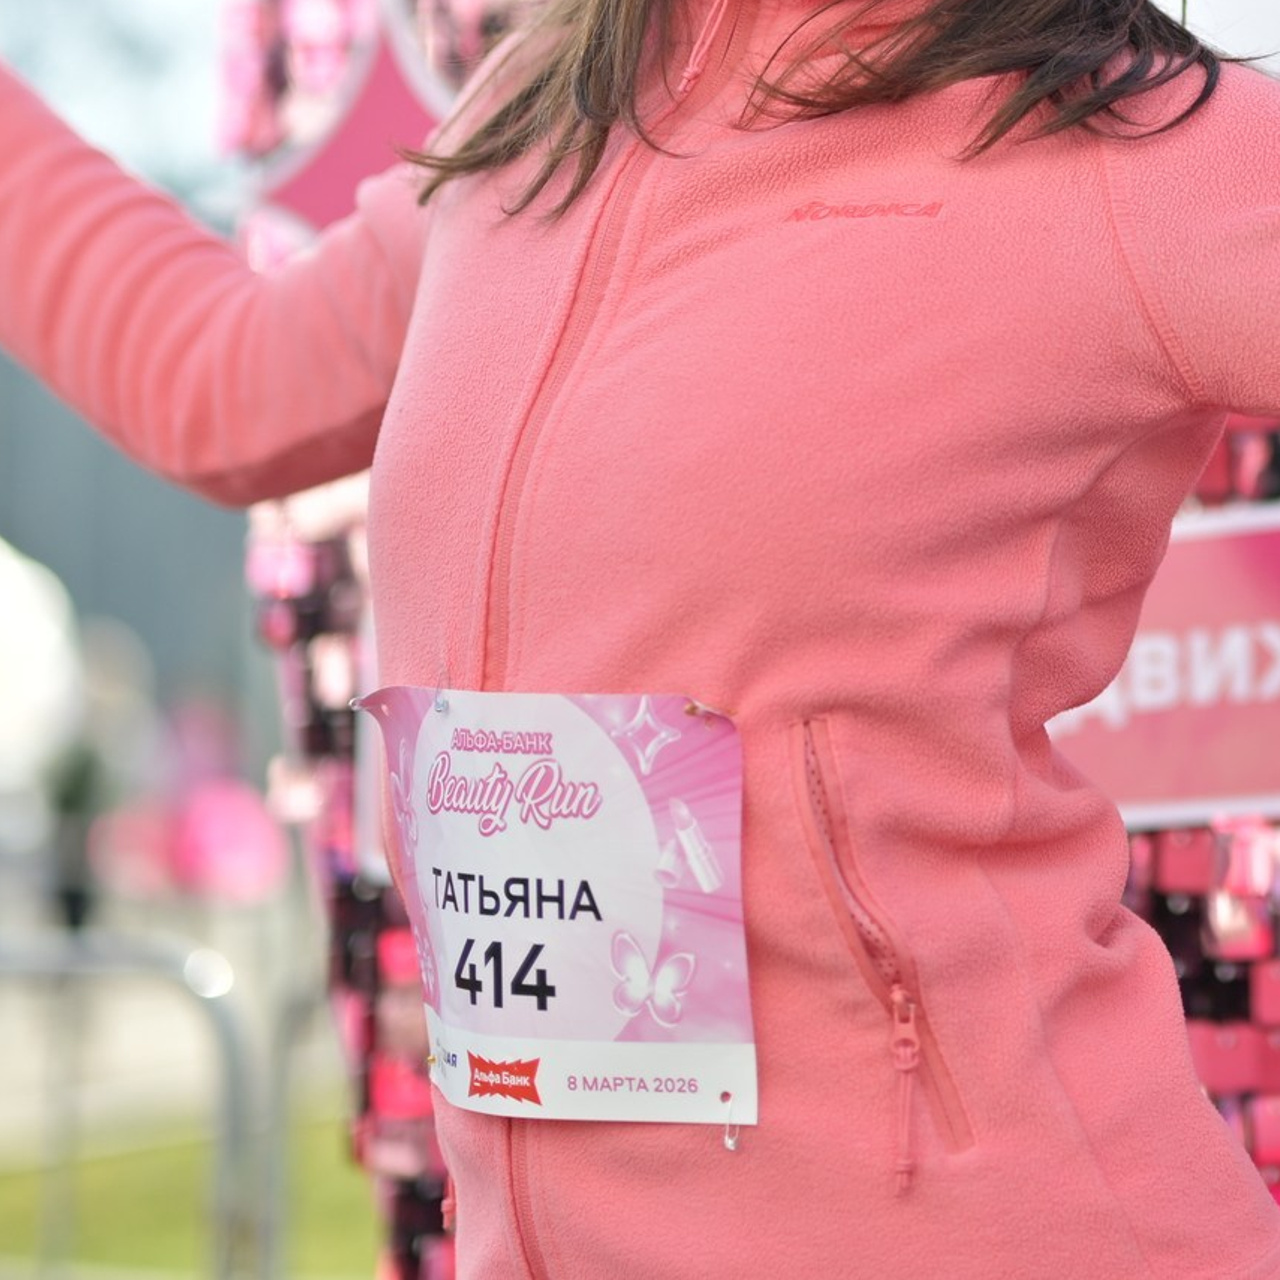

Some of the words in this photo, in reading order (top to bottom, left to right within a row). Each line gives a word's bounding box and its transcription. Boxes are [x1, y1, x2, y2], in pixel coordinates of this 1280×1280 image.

[451, 728, 553, 755] АЛЬФА-БАНК
[427, 752, 513, 837] Beauty
[514, 759, 602, 826] Run
[432, 867, 603, 921] ТАТЬЯНА
[454, 938, 556, 1011] 414
[473, 1068, 501, 1086] Альфа
[502, 1071, 531, 1087] Банк
[567, 1076, 577, 1091] 8
[582, 1077, 649, 1092] МАРТА
[654, 1077, 699, 1093] 2026
